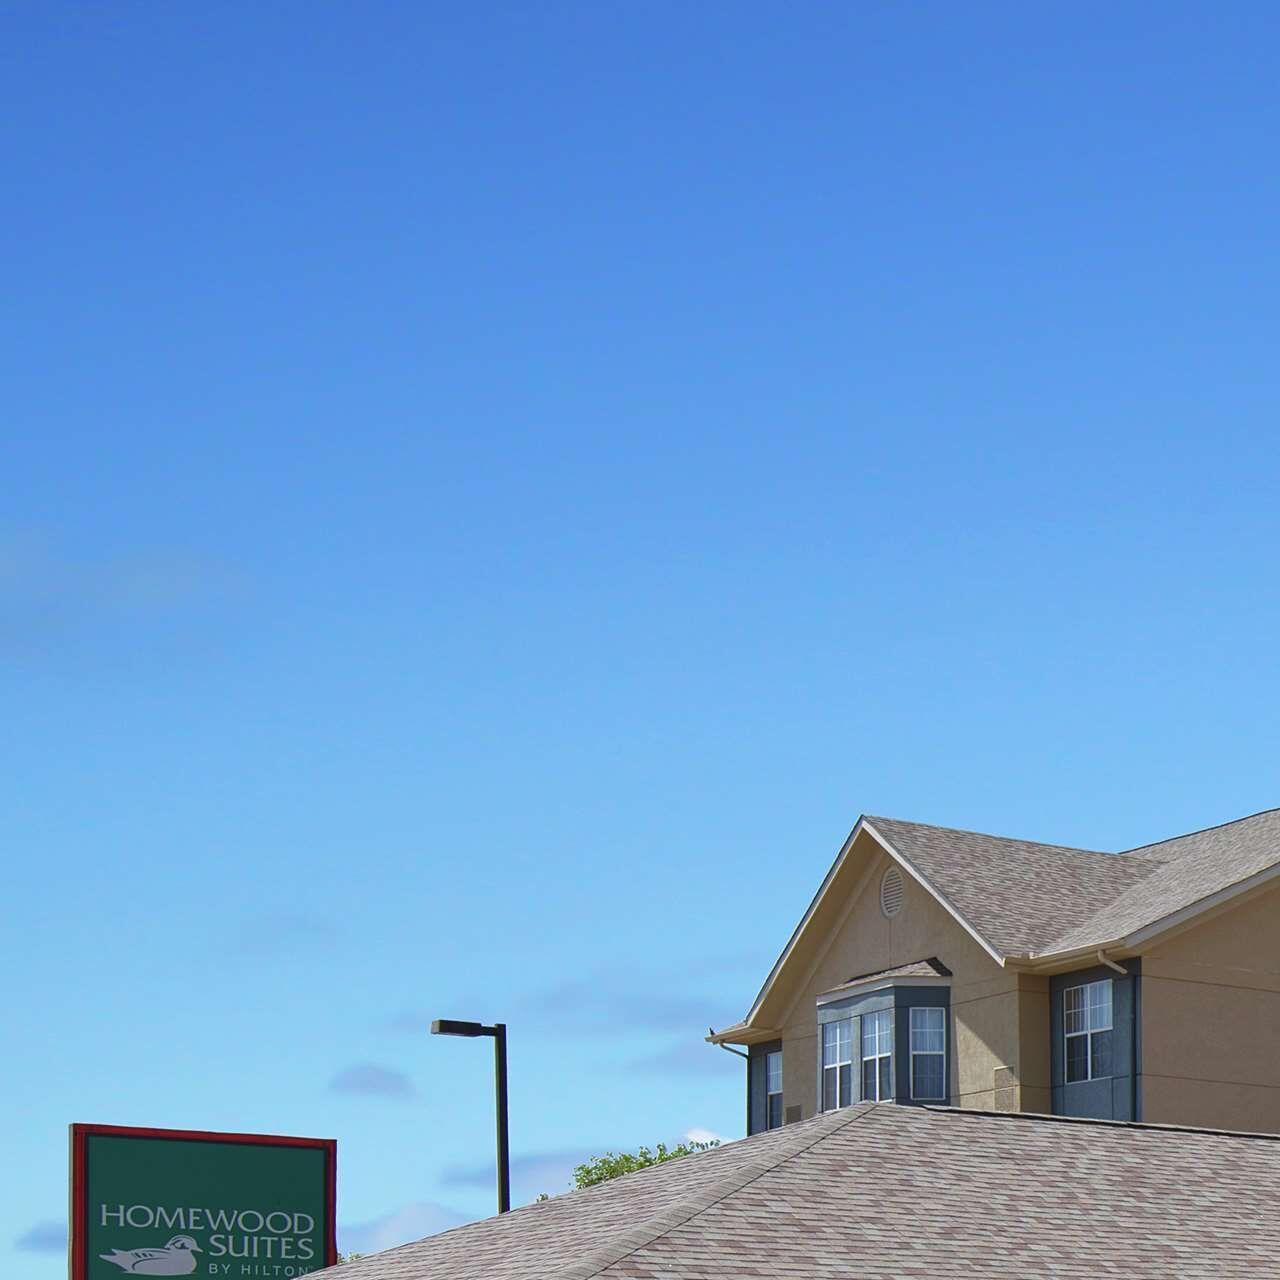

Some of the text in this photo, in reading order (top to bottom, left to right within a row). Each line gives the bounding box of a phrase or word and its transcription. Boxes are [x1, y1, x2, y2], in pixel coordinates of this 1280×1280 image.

[100, 1203, 314, 1234] HOMEWOOD
[209, 1234, 314, 1260] SUITES
[209, 1263, 309, 1277] BY HILTON
